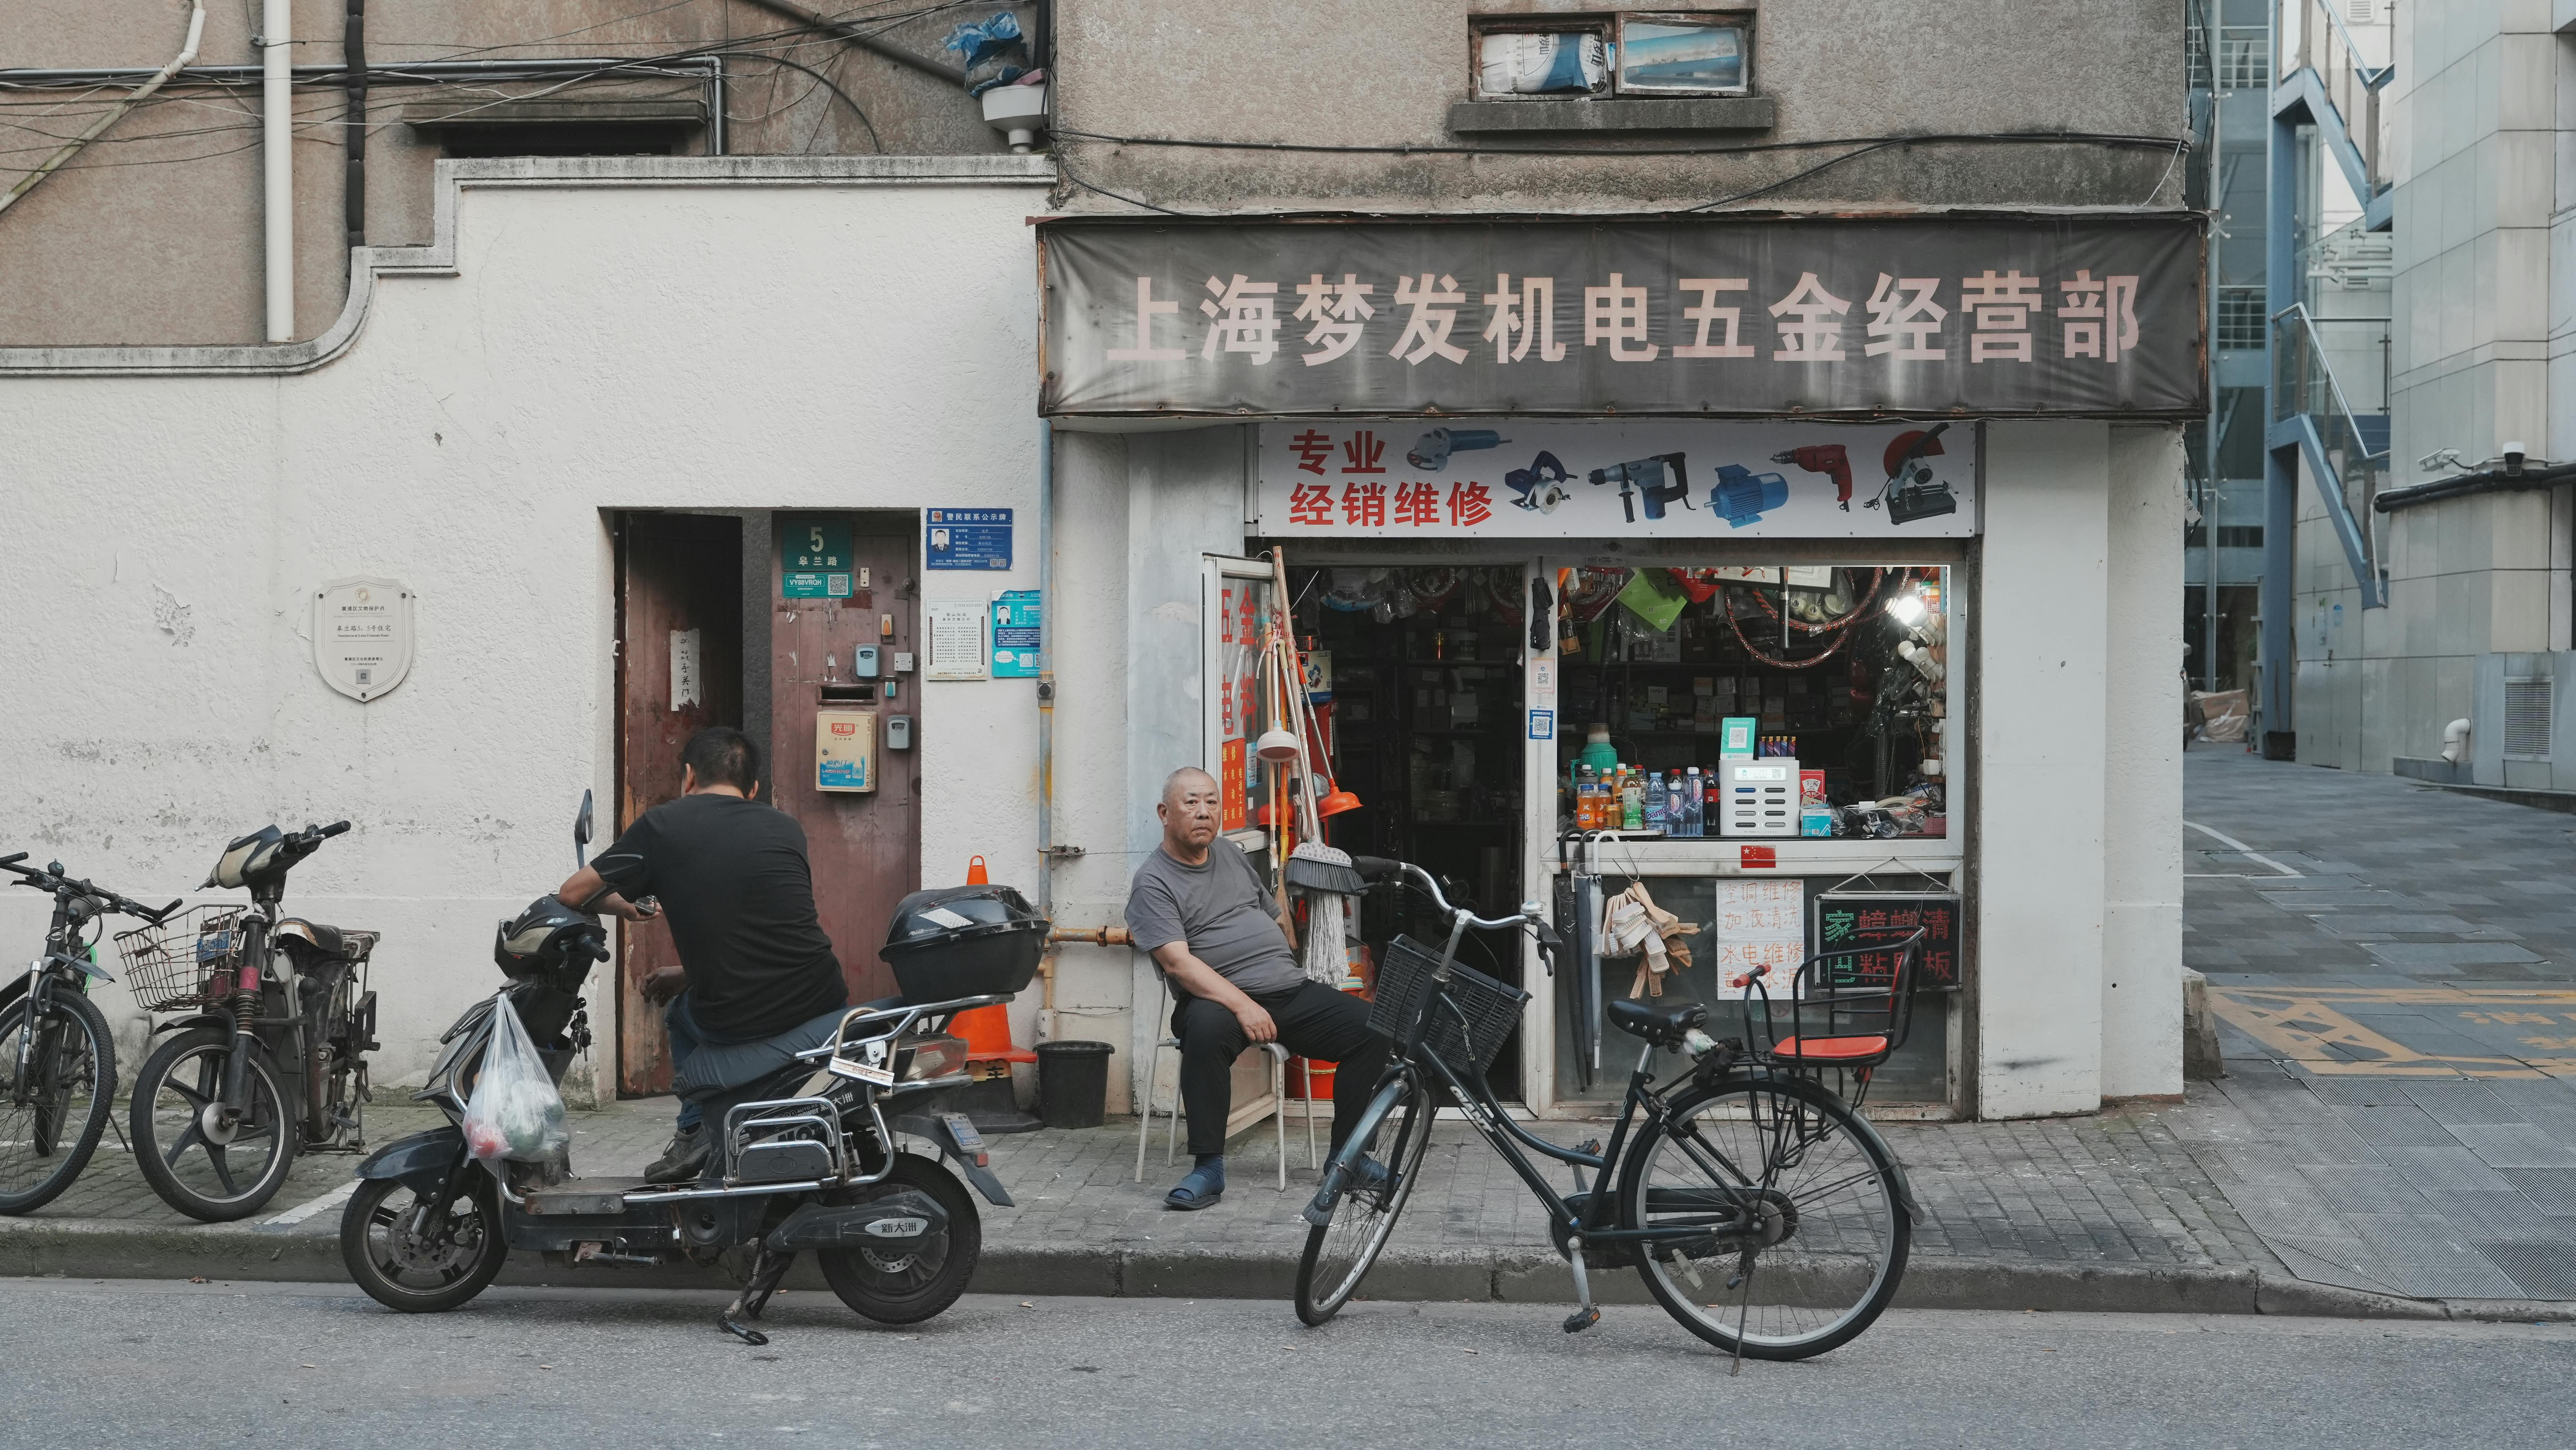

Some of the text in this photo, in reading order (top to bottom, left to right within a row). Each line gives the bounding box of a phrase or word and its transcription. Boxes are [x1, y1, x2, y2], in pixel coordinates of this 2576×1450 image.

[1107, 270, 2140, 367] 上海梦发机电五金经营部
[1289, 429, 1386, 476] 专业
[1289, 482, 1493, 527] 经销维修
[947, 513, 1006, 521] 警民联系公示牌
[811, 527, 824, 552] 5
[798, 556, 837, 566] 皋兰路
[833, 724, 853, 732] 光明
[1222, 746, 1236, 762] 维修
[1724, 881, 1803, 904] 空调维修
[1725, 904, 1801, 930] 加液清洗
[1721, 942, 1804, 965] 水电维修
[1723, 968, 1801, 994] 黄水泥
[1449, 1085, 1495, 1133] GIANT
[881, 1223, 917, 1233] 新大洲
